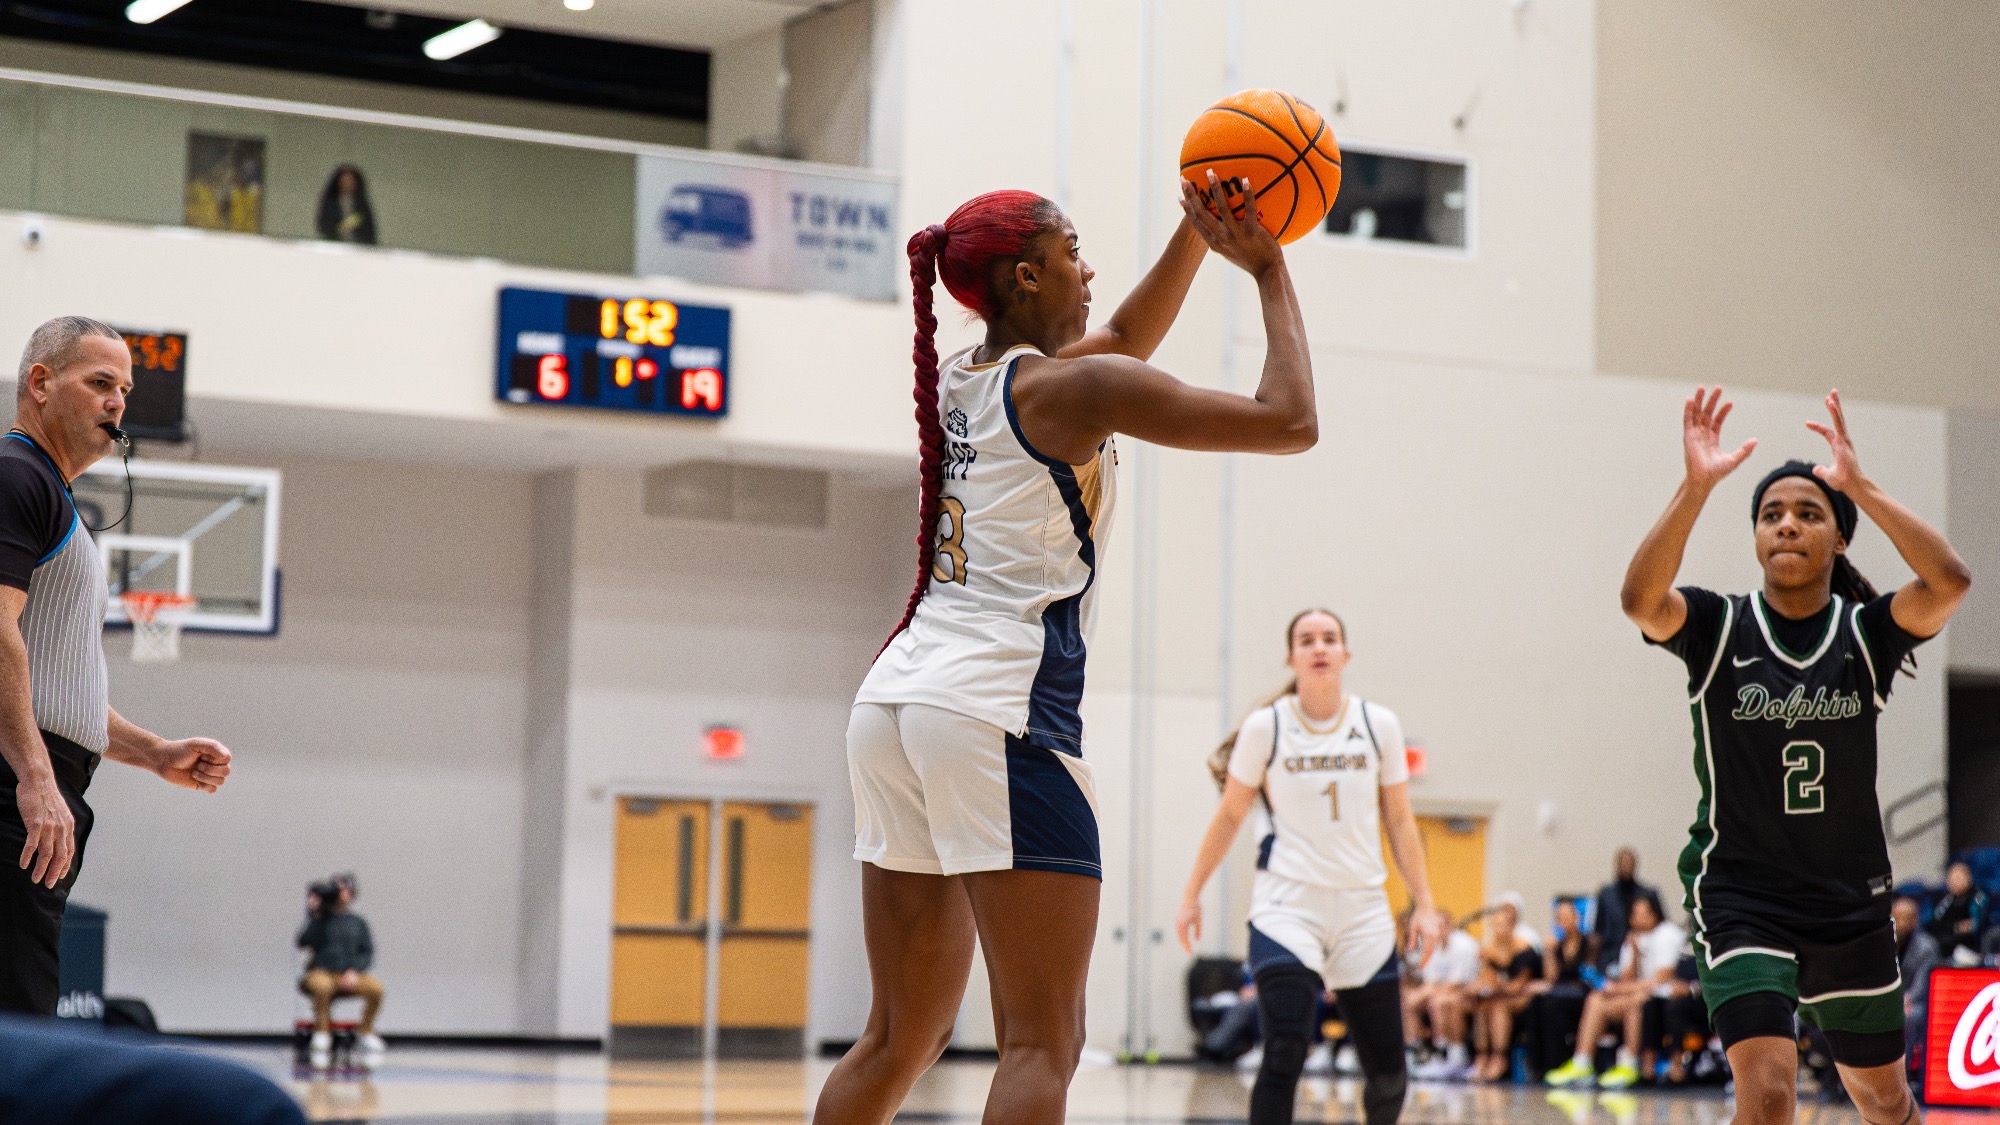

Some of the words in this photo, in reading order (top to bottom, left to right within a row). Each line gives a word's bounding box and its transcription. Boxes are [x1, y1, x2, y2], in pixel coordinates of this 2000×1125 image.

[790, 191, 889, 231] TOWN
[537, 353, 570, 400] 6
[615, 356, 633, 388] 1
[681, 367, 723, 411] 19
[942, 441, 977, 480] APP
[1732, 683, 1861, 729] Dolphins
[1782, 741, 1824, 814] 2
[1320, 781, 1339, 822] 1
[57, 989, 104, 1018] alth
